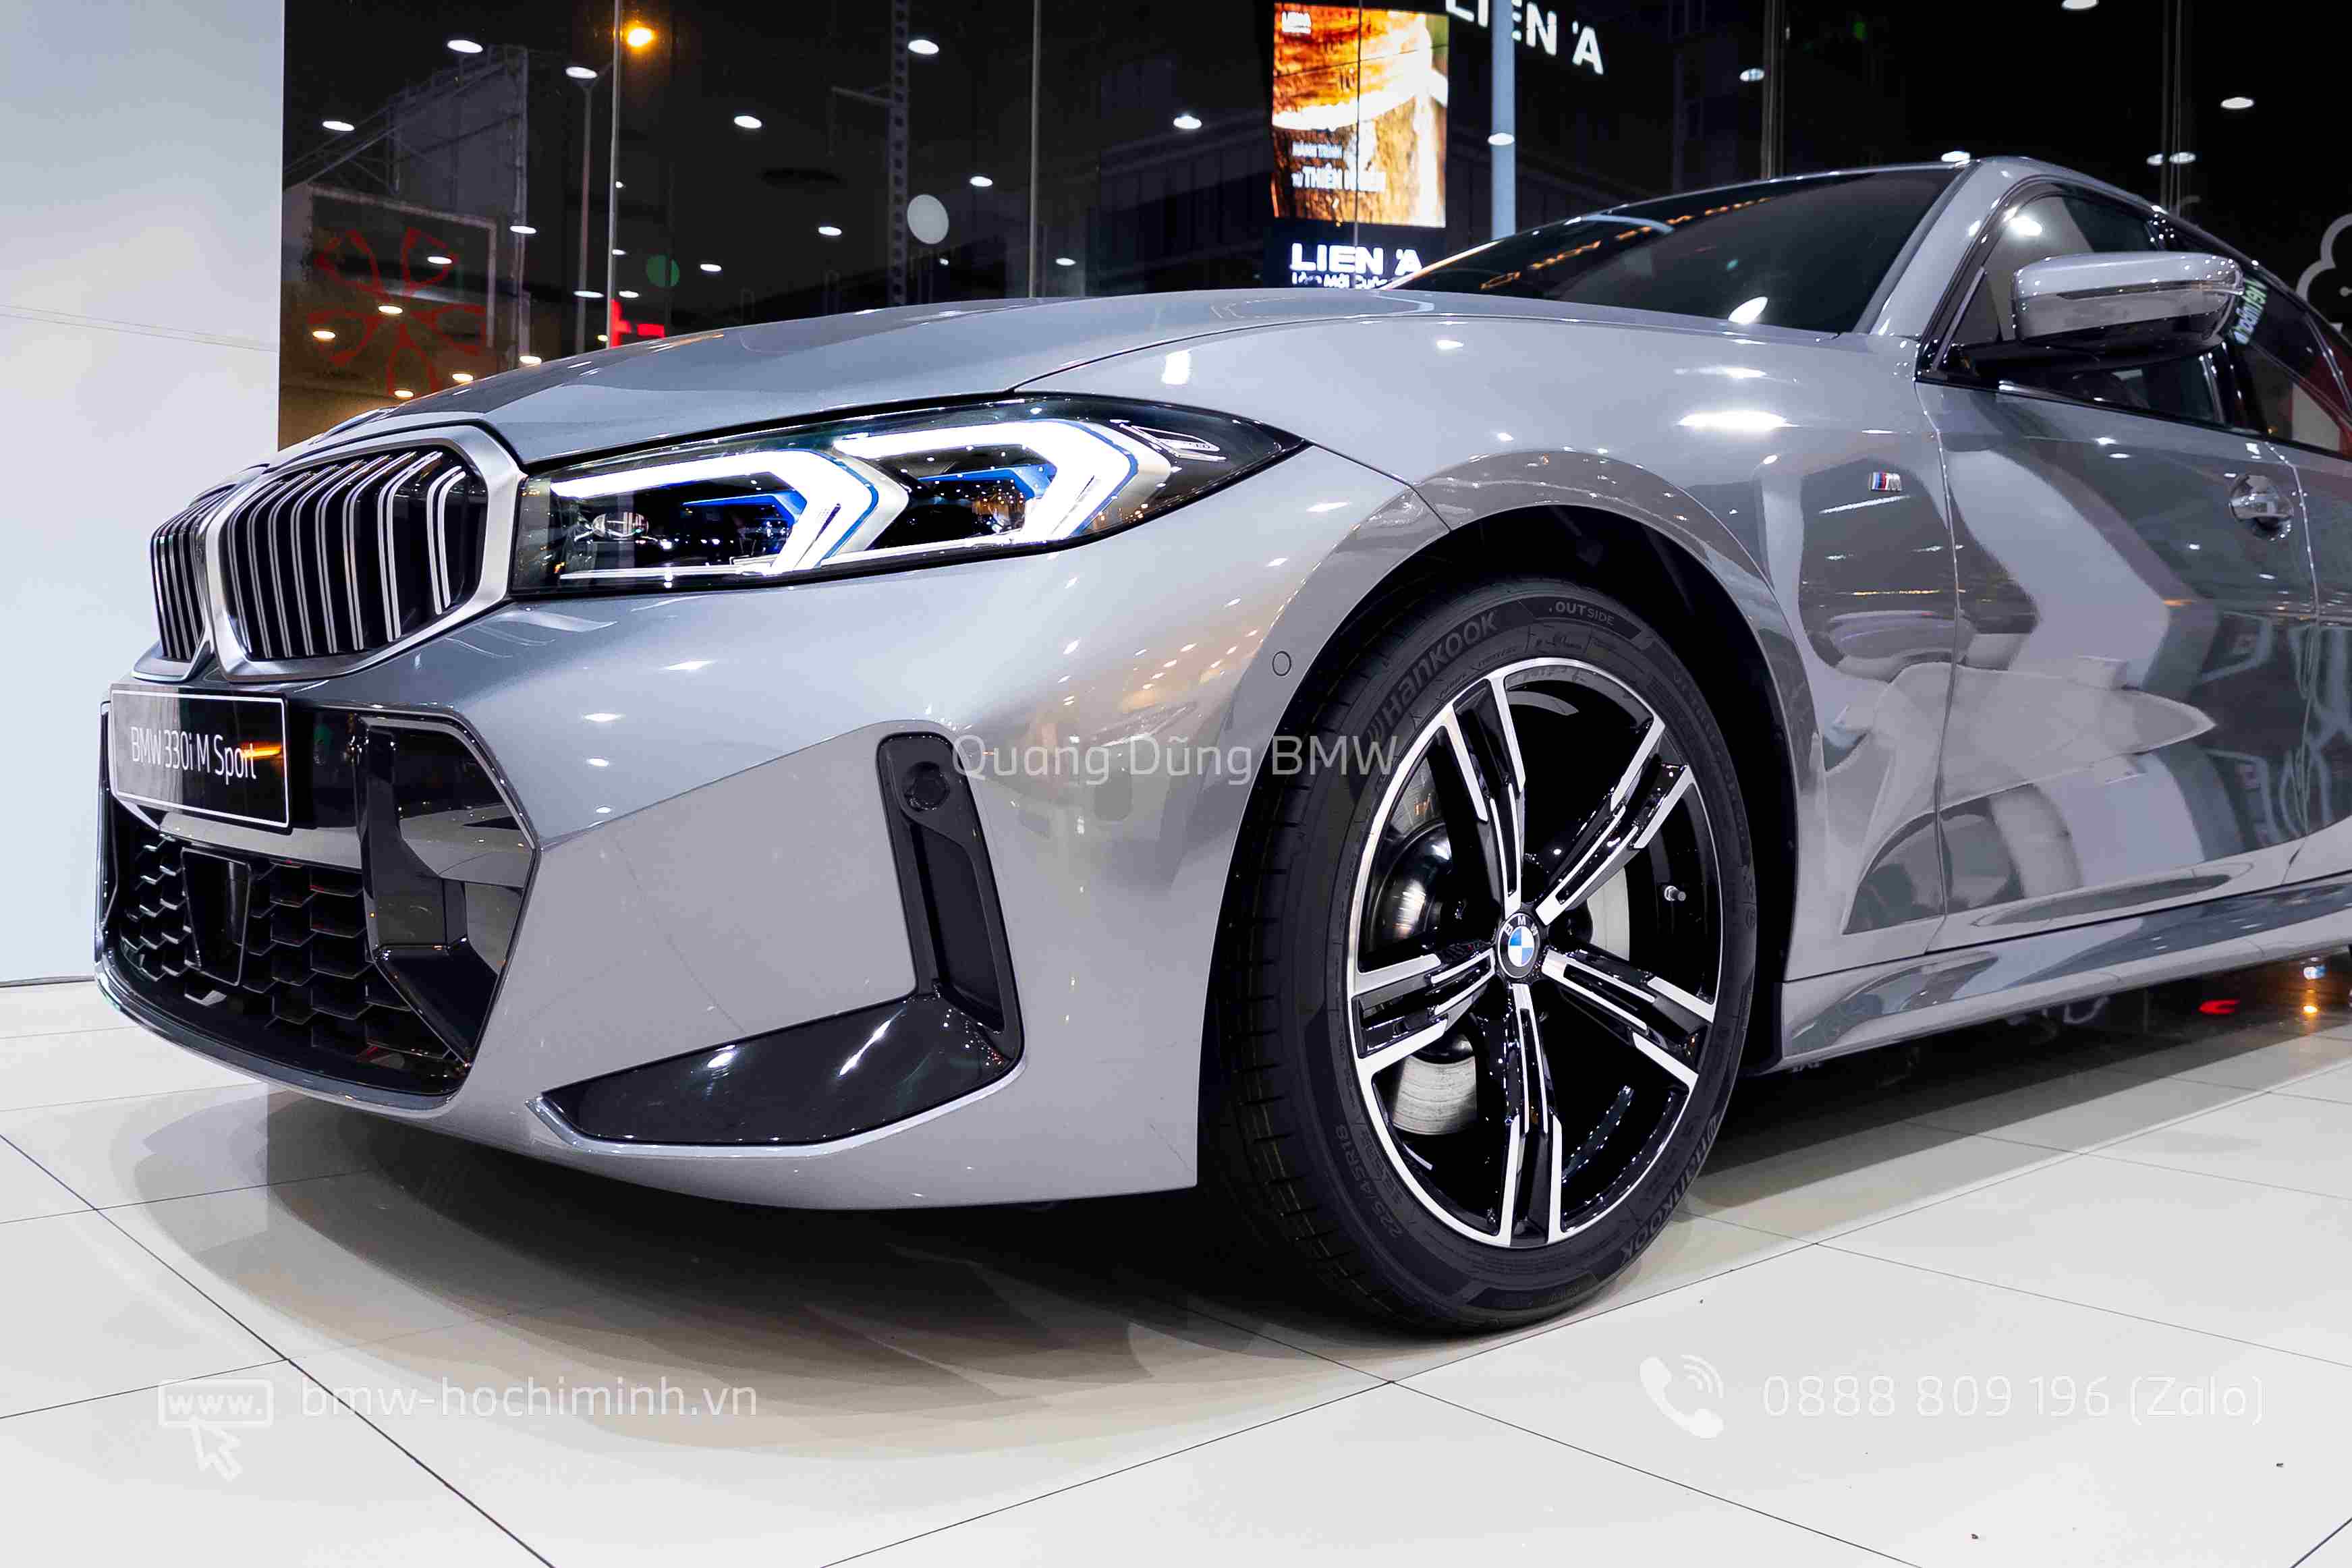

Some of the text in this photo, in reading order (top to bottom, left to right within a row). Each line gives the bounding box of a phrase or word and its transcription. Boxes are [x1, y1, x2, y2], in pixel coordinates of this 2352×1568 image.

[1289, 243, 1384, 275] LIEN
[1555, 600, 1615, 627] OUTSIDE
[130, 727, 256, 785] BMW 330i M Sport
[1504, 915, 1539, 936] BMW
